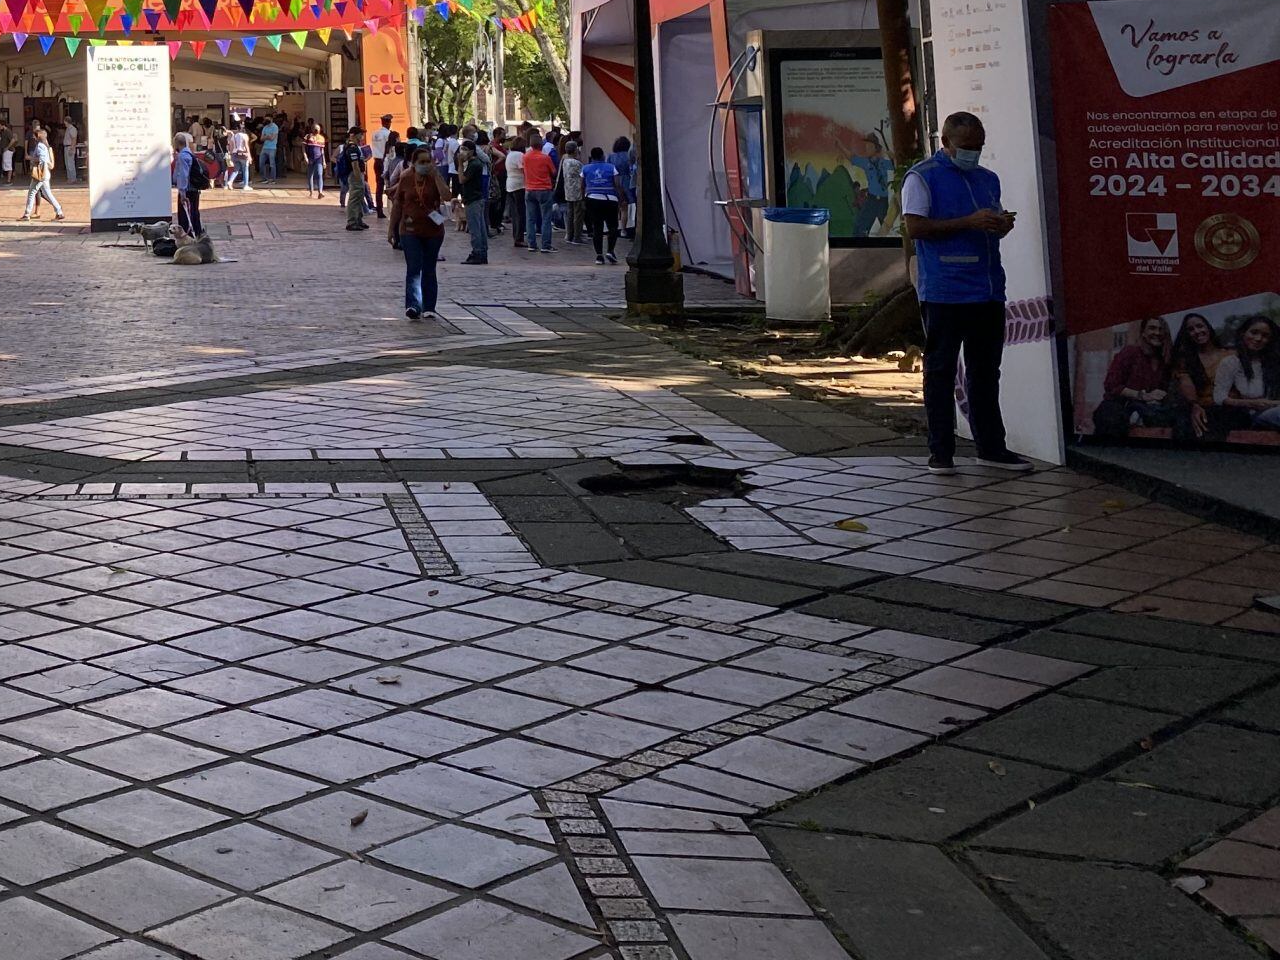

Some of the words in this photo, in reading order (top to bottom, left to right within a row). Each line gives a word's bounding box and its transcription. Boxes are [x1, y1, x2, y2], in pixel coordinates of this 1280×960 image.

[1120, 18, 1200, 48] Vamos
[1207, 29, 1222, 40] a
[1146, 42, 1240, 76] lograrla
[1086, 111, 1110, 121] Nos
[1112, 110, 1196, 120] encontramos
[1199, 111, 1216, 119] en
[1218, 109, 1258, 121] etapa
[1260, 108, 1278, 118] de
[1087, 123, 1181, 133] autoevaluación
[1183, 123, 1213, 134] para
[1216, 122, 1264, 132] renovar
[1267, 121, 1279, 131] la
[1088, 138, 1182, 149] Acreditación
[1186, 136, 1280, 149] Institucional
[1089, 155, 1118, 169] en
[1125, 152, 1175, 169] Alta
[1180, 150, 1280, 169] Calidad
[1089, 174, 1168, 197] 2024
[1201, 174, 1280, 197] 2034
[1128, 257, 1180, 265] Universidad
[1136, 265, 1150, 273] del
[1152, 265, 1173, 273] Valle
